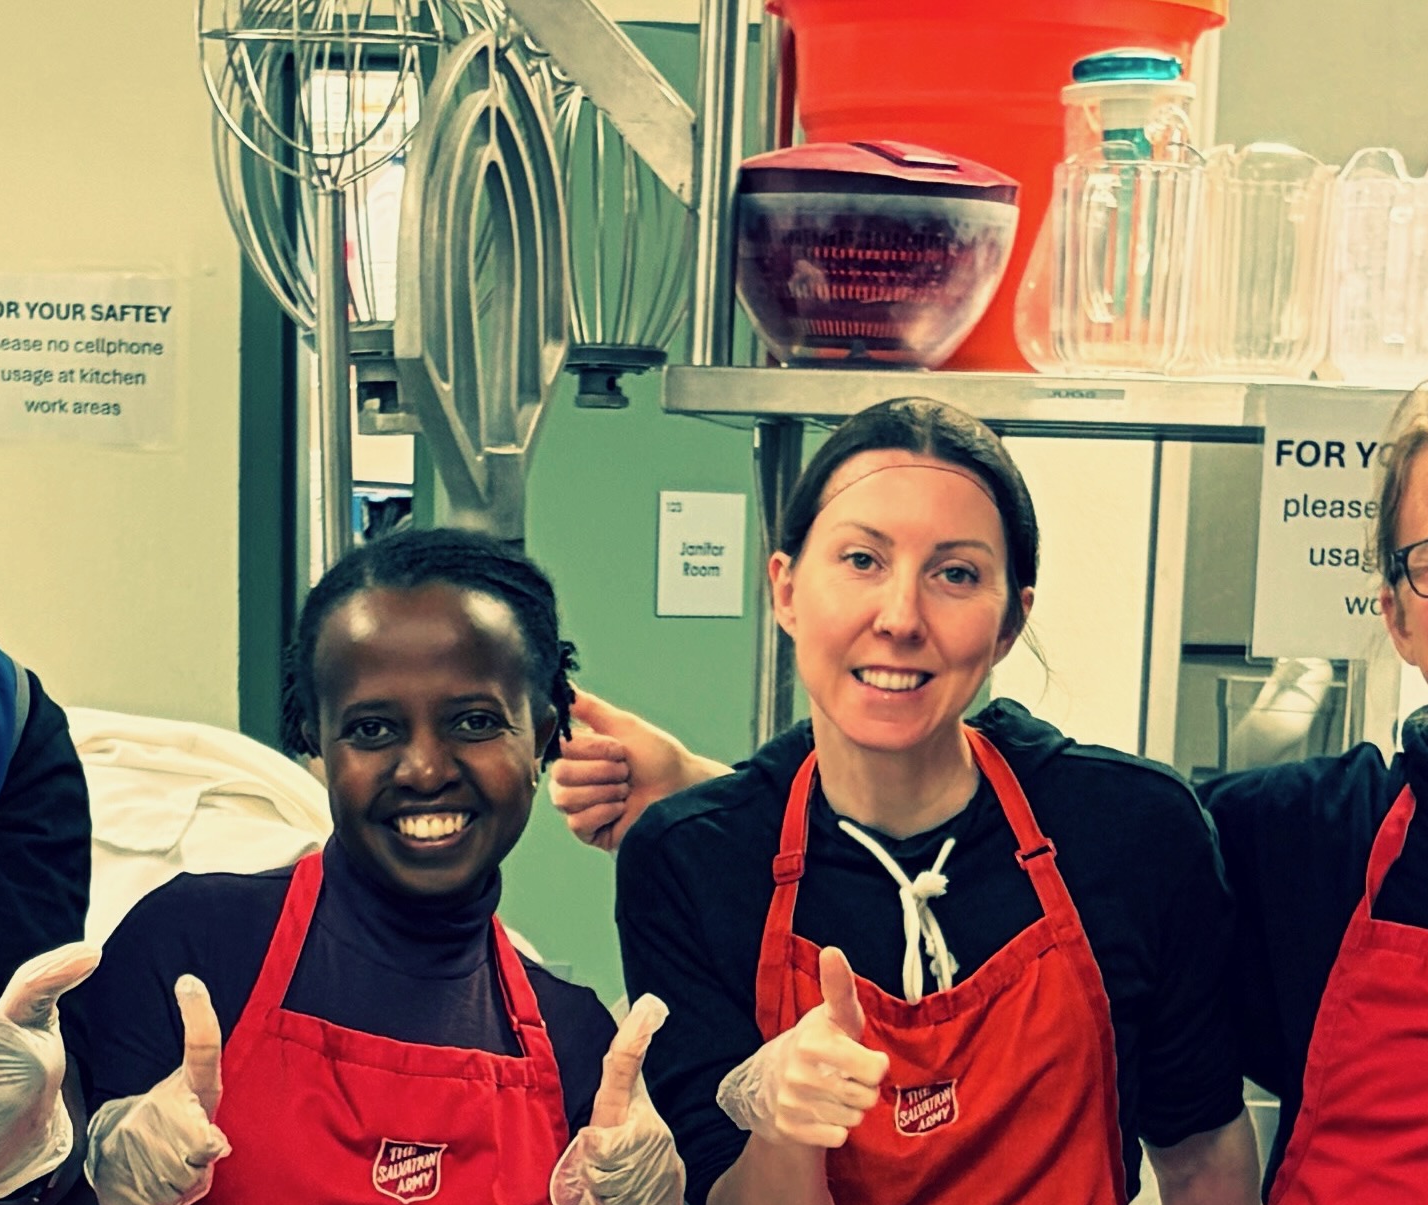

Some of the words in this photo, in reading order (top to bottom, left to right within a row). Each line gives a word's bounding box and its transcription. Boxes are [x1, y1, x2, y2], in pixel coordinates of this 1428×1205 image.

[25, 301, 85, 321] YOUR
[91, 304, 172, 323] SAFTEY
[47, 339, 69, 352] no
[74, 338, 163, 356] cellphone
[1, 369, 53, 386] usage
[58, 368, 75, 383] at
[79, 368, 146, 385] kitchen
[25, 399, 68, 414] work
[72, 401, 121, 416] areas
[1275, 439, 1345, 469] FOR
[1355, 441, 1394, 469] YO
[1283, 493, 1380, 522] please
[683, 561, 720, 577] Room
[1309, 546, 1376, 573] usag
[900, 1086, 951, 1127] SALVATION
[906, 1088, 931, 1105] THE
[918, 1104, 950, 1132] ARMY
[390, 1146, 417, 1161] THE
[377, 1151, 438, 1183] SALVATION
[396, 1169, 433, 1194] ARMY
